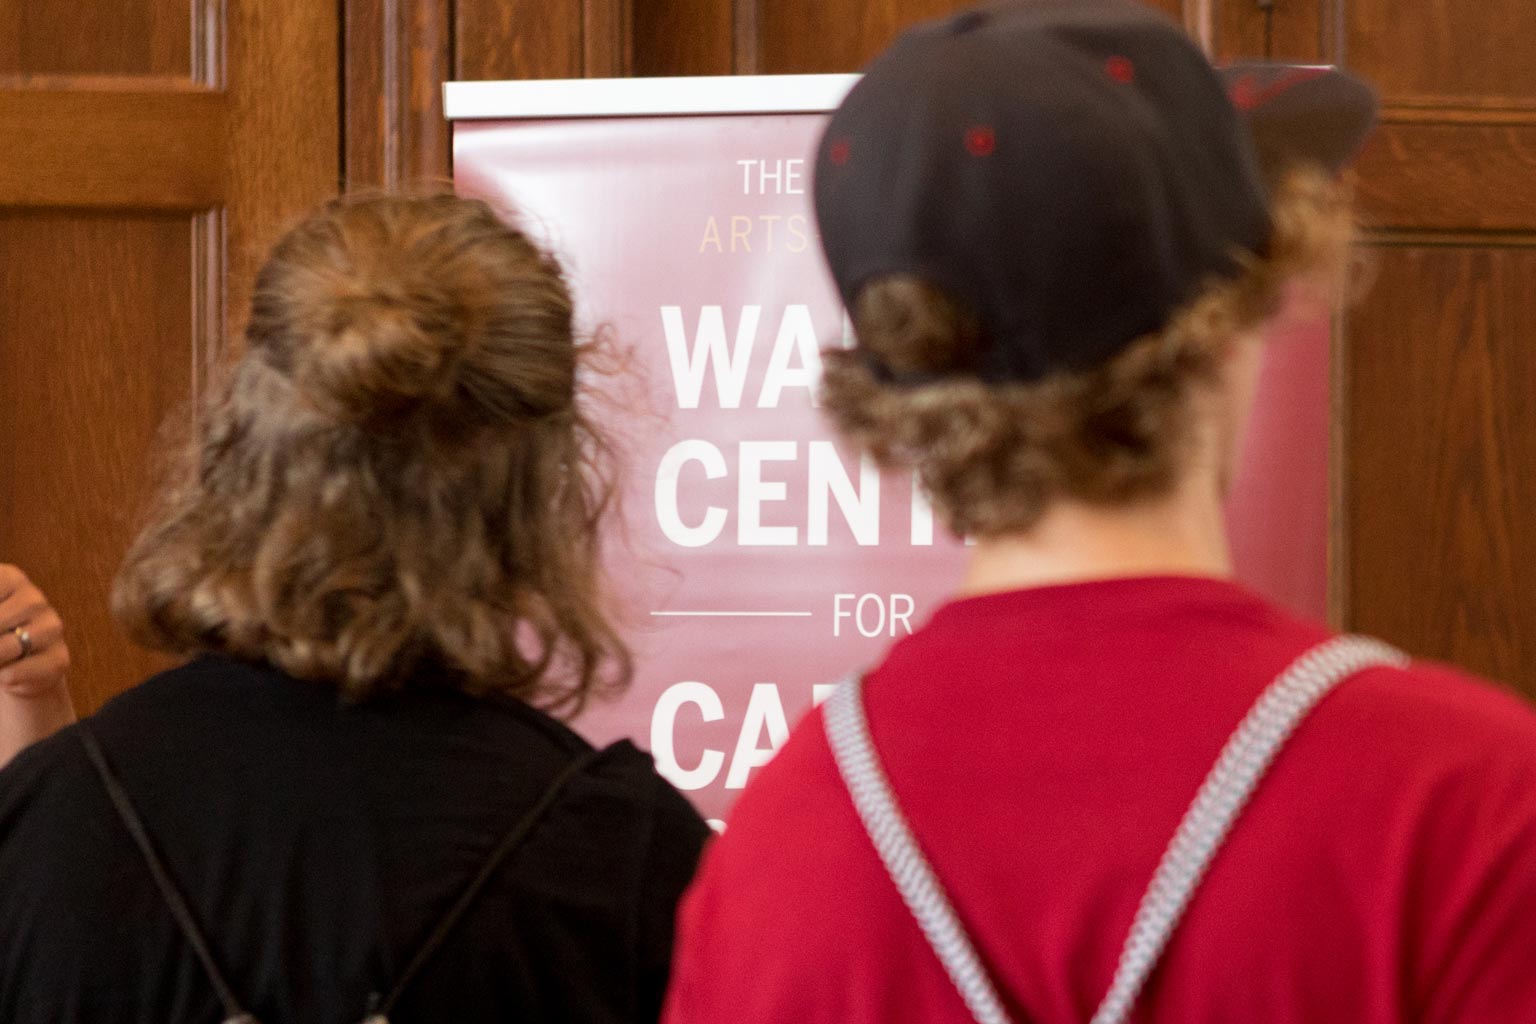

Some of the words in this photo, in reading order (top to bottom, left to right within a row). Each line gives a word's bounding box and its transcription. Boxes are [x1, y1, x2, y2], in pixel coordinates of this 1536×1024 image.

[737, 159, 804, 194] THE
[700, 215, 807, 252] ARTS
[654, 439, 977, 547] CEN
[833, 593, 915, 637] FOR
[650, 681, 838, 790] CA
